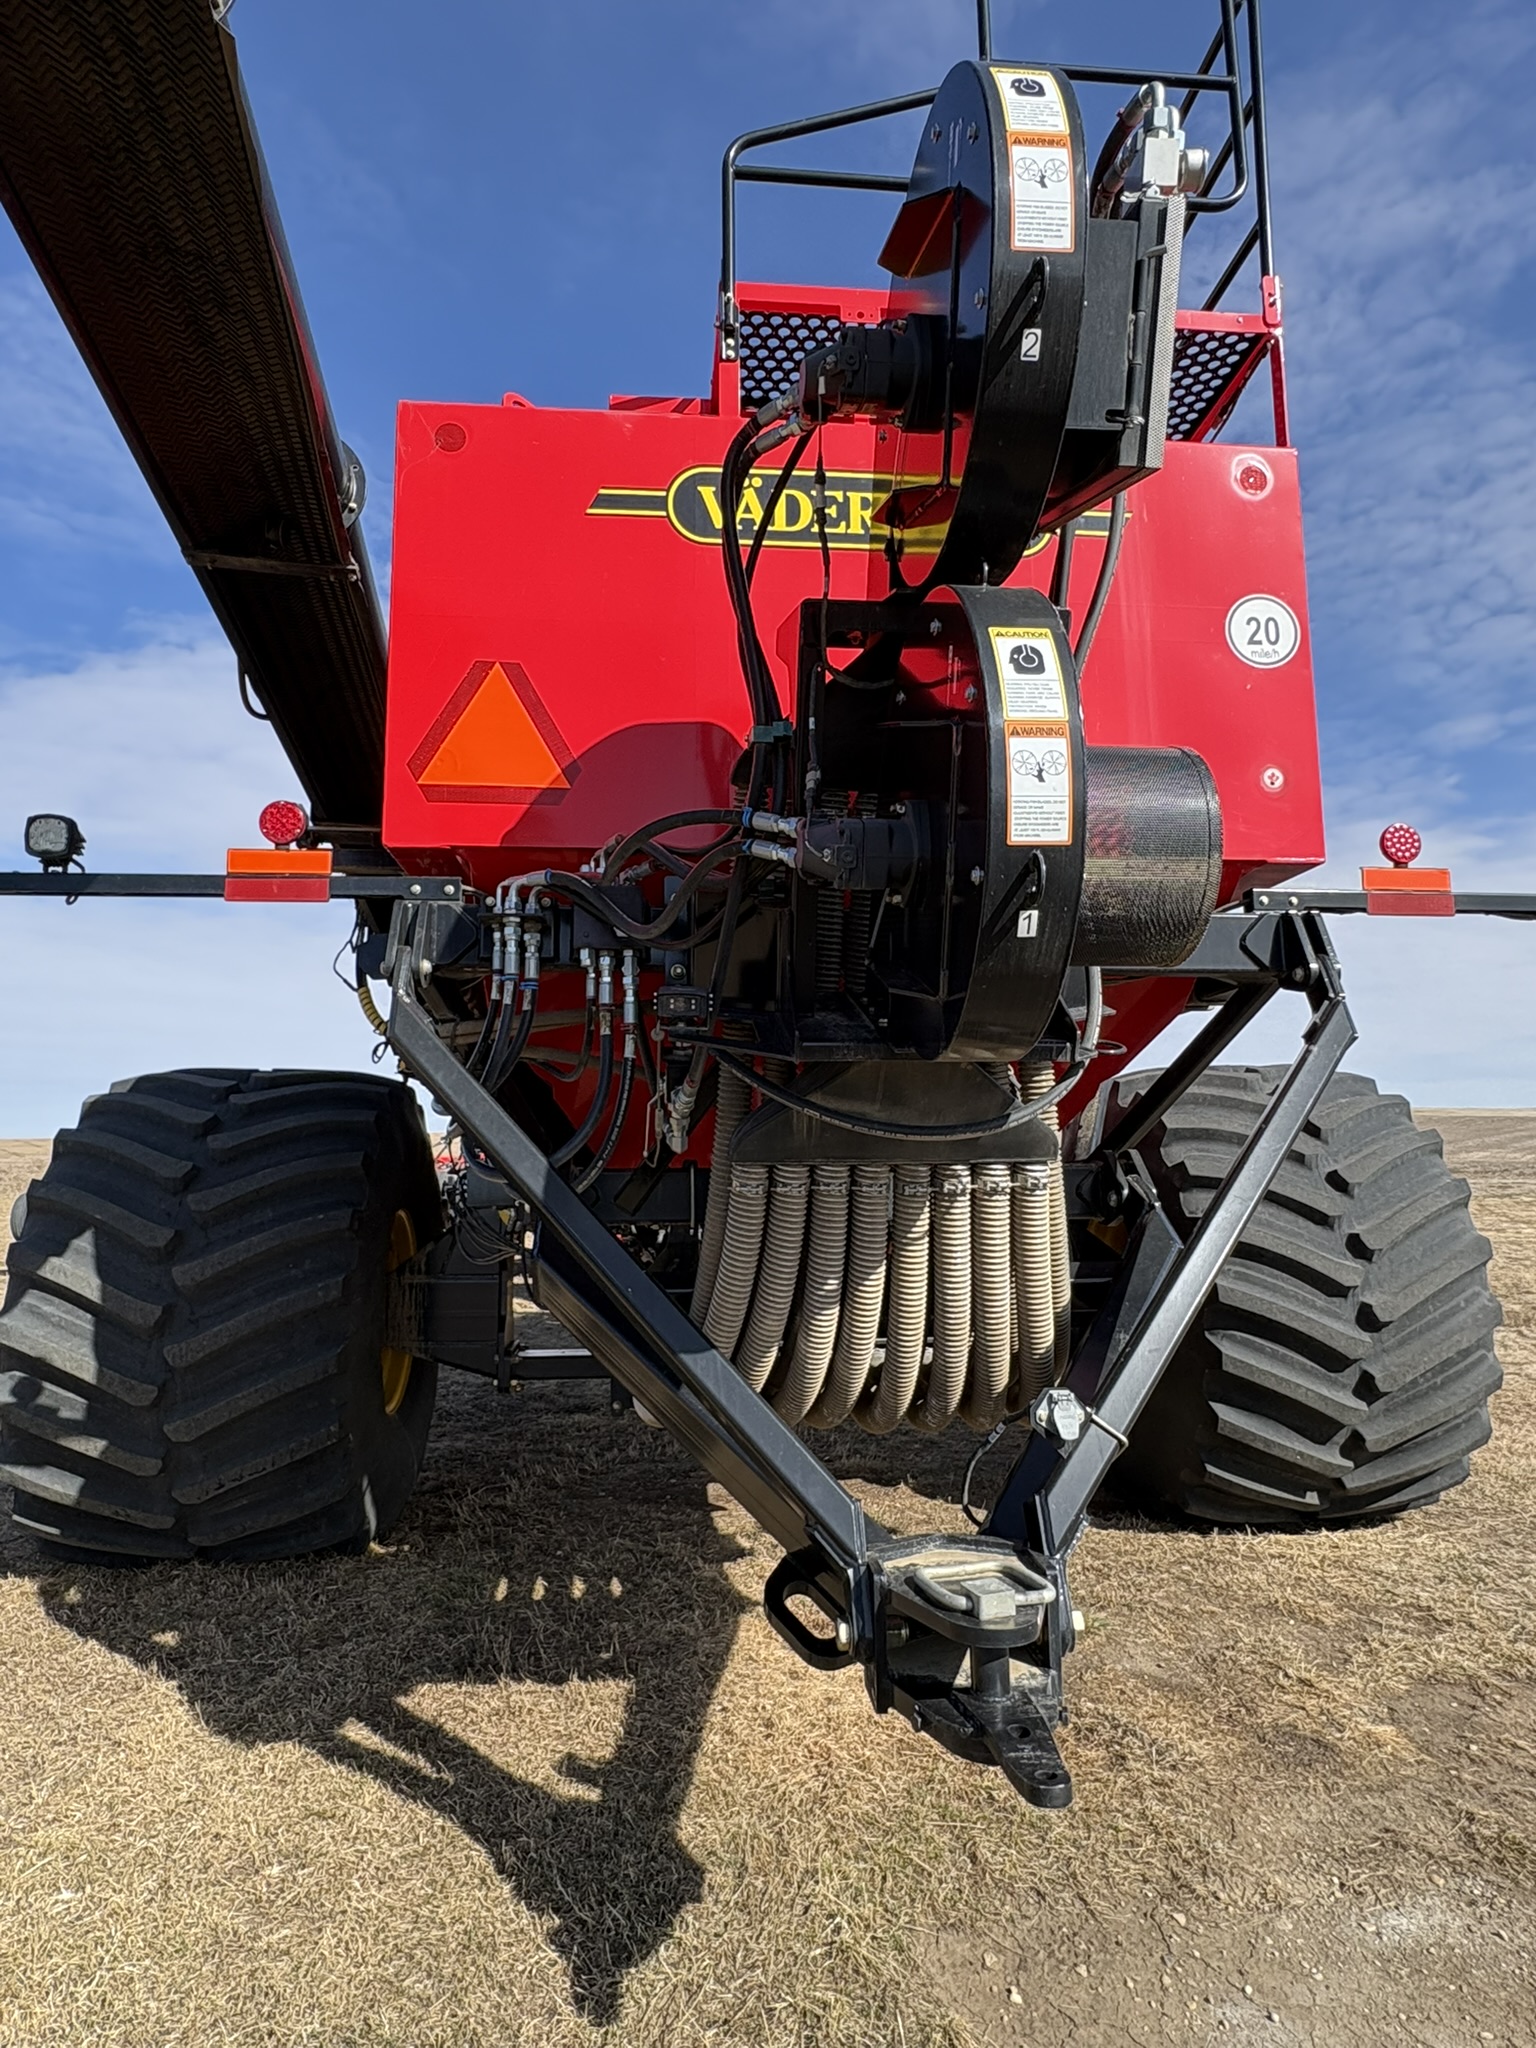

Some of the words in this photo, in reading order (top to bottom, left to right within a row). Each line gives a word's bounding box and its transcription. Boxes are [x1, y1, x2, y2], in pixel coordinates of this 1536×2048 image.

[1021, 136, 1066, 147] WARNING
[1022, 331, 1039, 358] 2
[696, 476, 874, 536] VÄDER
[1004, 630, 1049, 638] CAUTION
[1245, 616, 1280, 646] 20
[1250, 648, 1280, 659] mile/h
[1020, 727, 1065, 737] WARNING
[1022, 912, 1032, 935] 1
